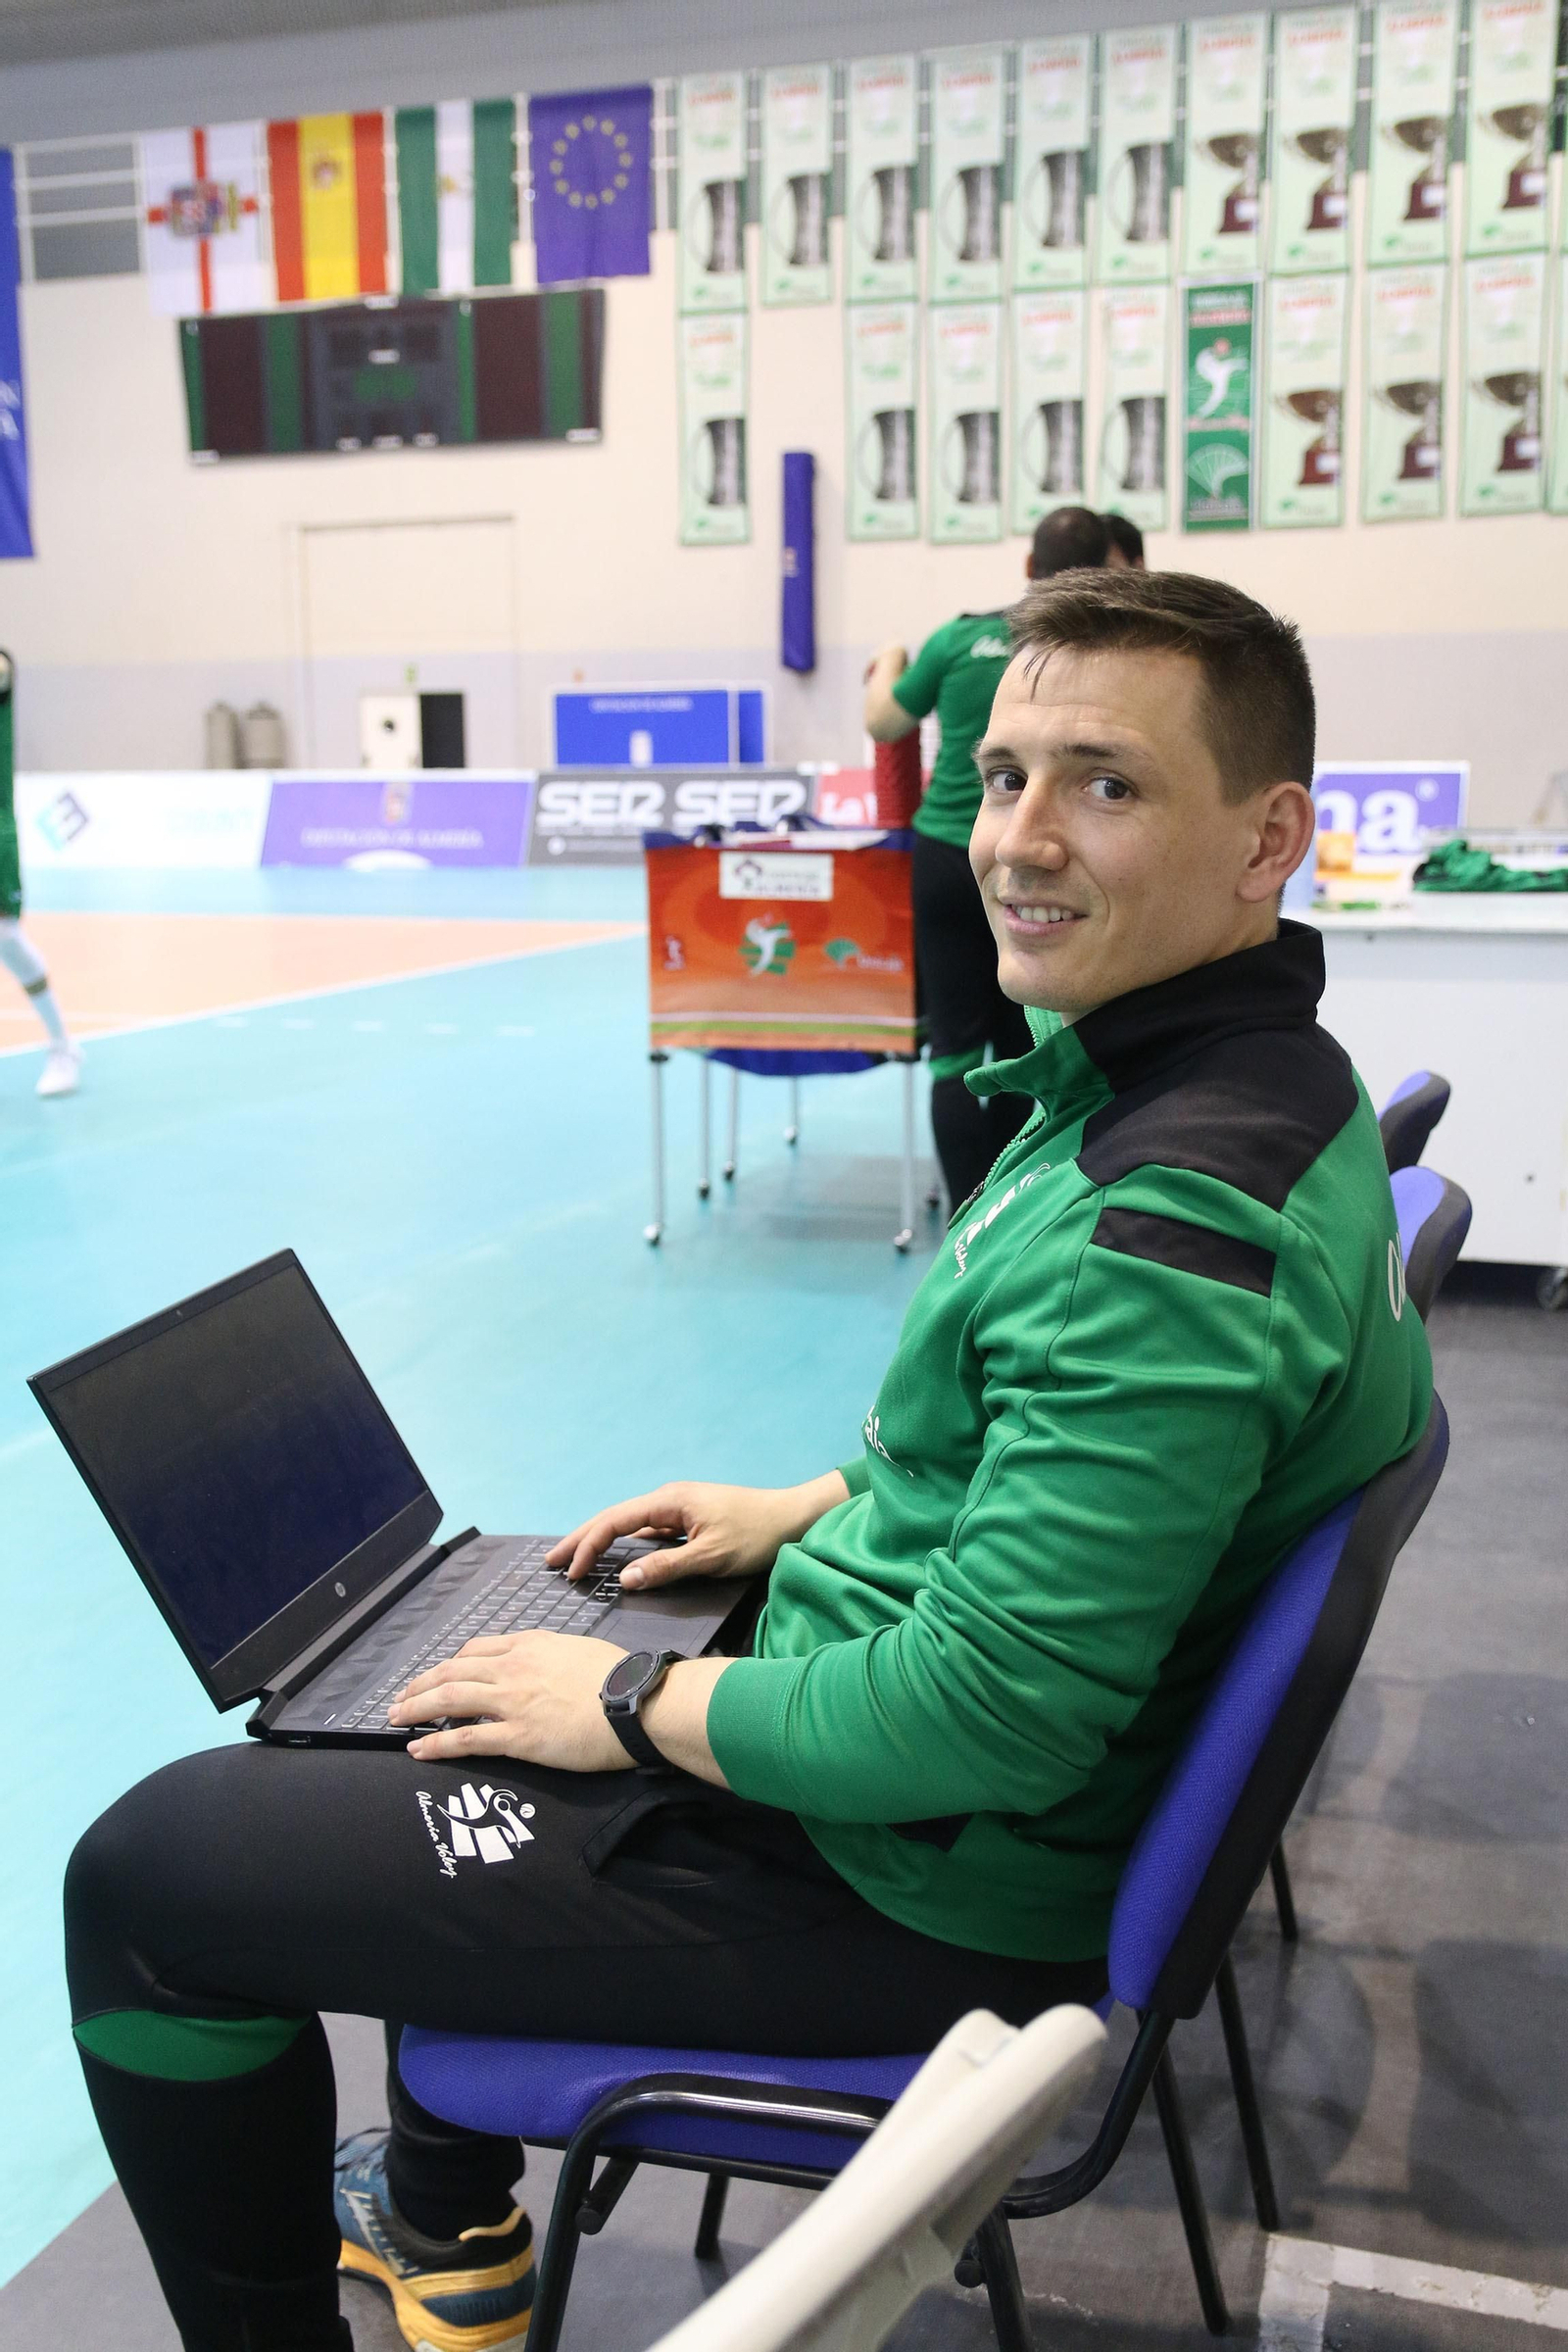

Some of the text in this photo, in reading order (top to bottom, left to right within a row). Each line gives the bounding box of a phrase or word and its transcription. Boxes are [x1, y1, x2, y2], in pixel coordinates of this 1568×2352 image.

[537, 780, 807, 827] SER SER
[435, 1841, 458, 1879] Voley
